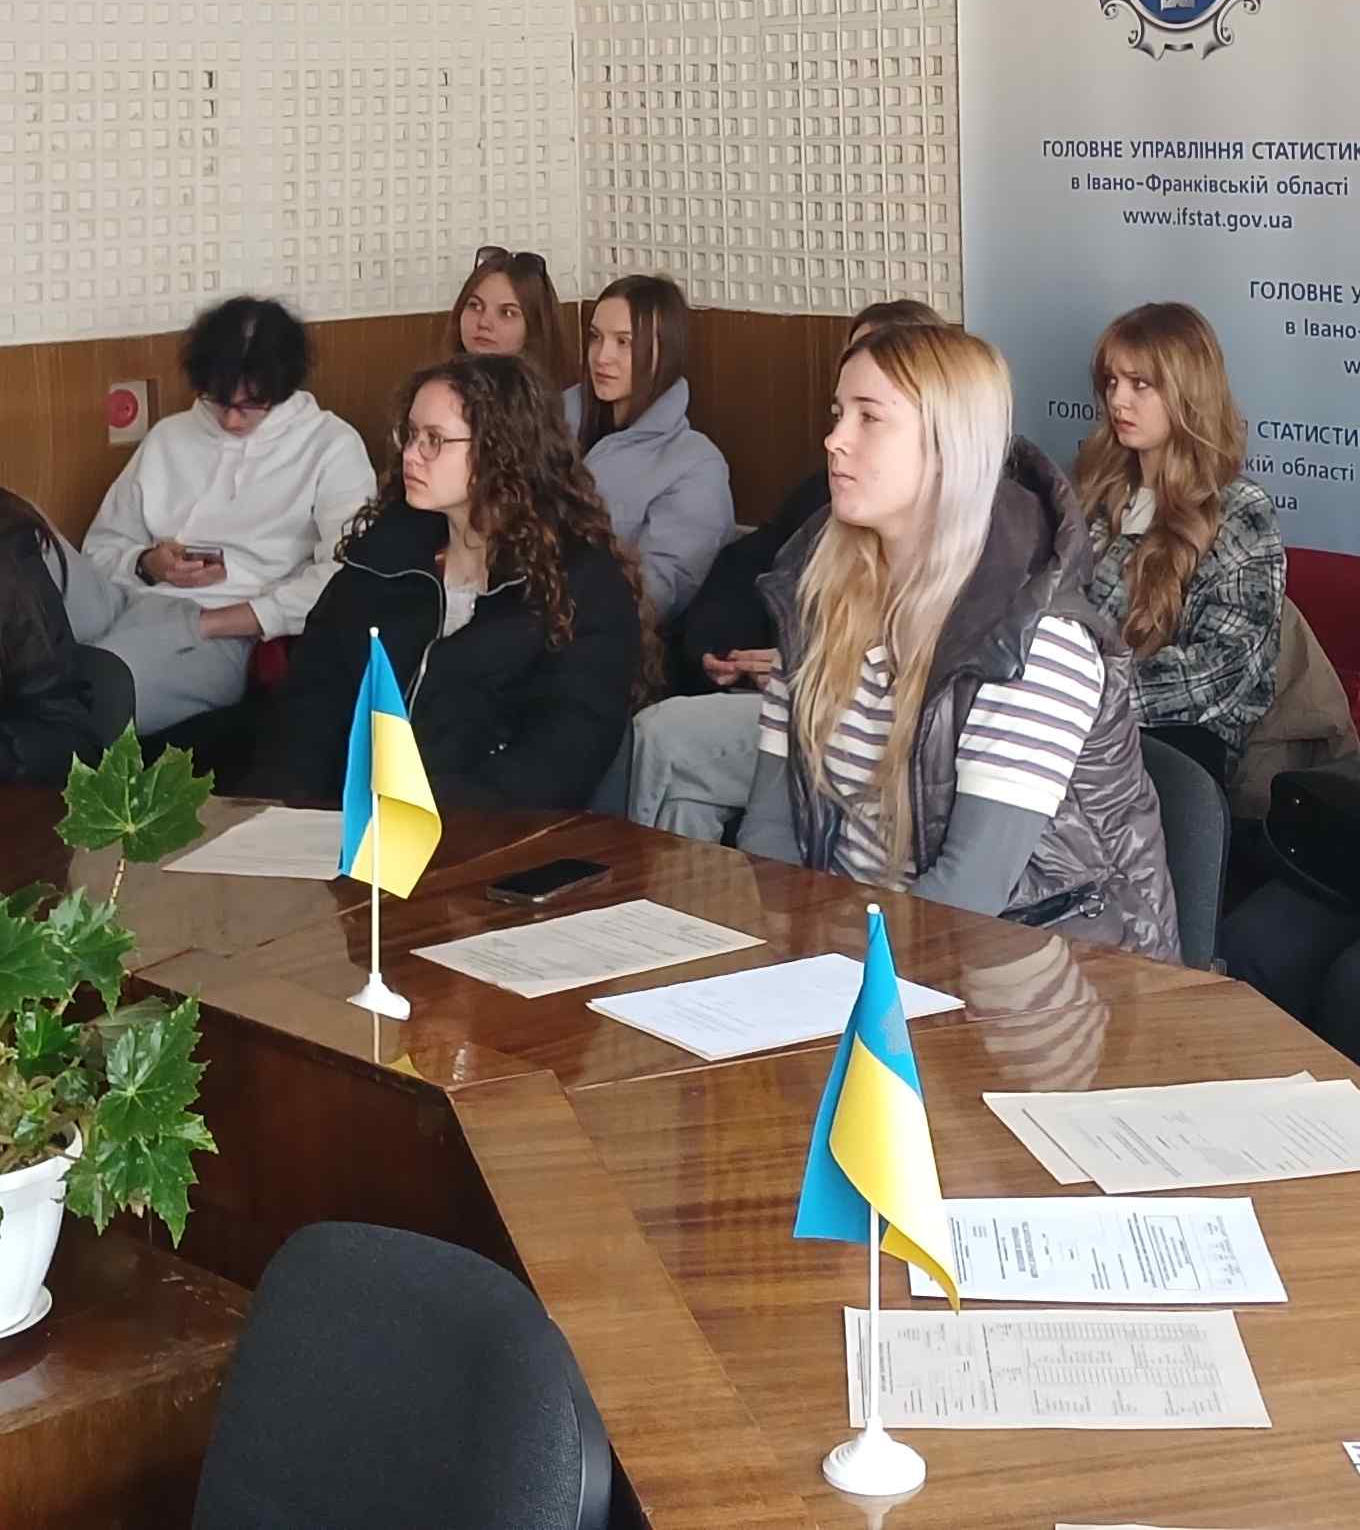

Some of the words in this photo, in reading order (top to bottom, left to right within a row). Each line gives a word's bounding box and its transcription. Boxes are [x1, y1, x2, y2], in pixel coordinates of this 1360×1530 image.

[1043, 140, 1123, 158] ГОЛОВНЕ
[1130, 141, 1243, 159] УПРАВЛІННЯ
[1072, 177, 1080, 190] в
[1087, 173, 1268, 196] Івано-Франківській
[1277, 175, 1348, 195] області
[1123, 207, 1292, 232] www.ifstat.gov.ua
[1250, 281, 1343, 303] ГОЛОВНЕ
[1286, 322, 1295, 334] в
[1283, 457, 1353, 481] області
